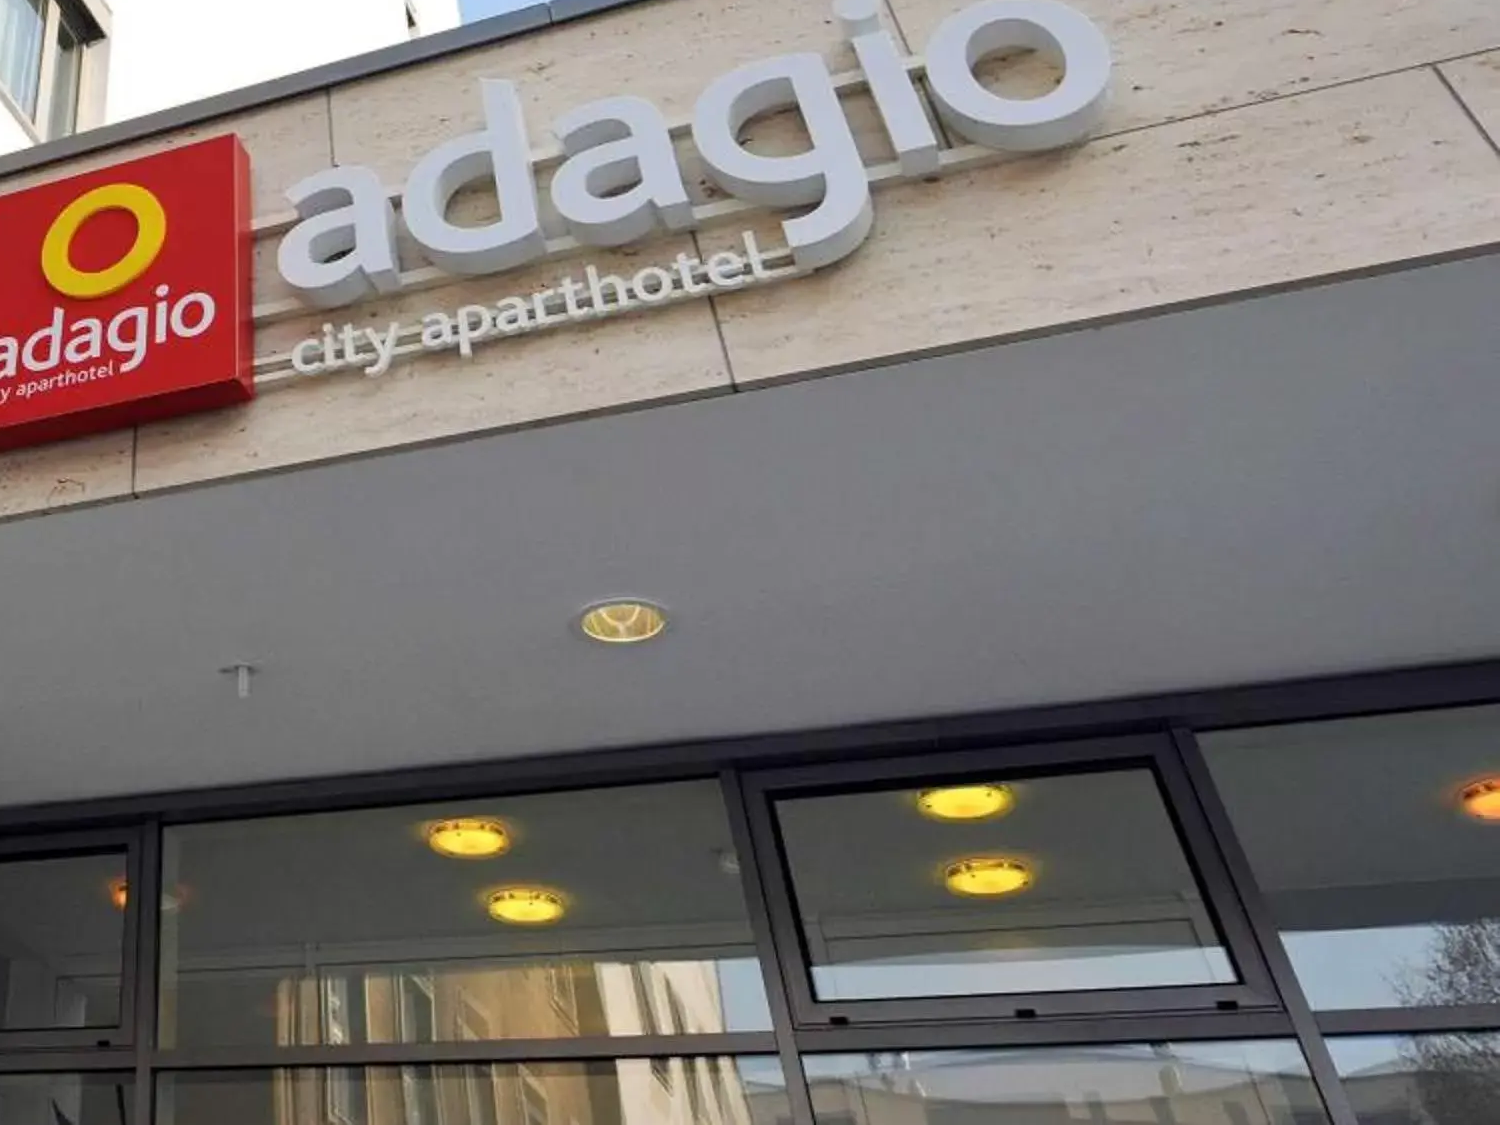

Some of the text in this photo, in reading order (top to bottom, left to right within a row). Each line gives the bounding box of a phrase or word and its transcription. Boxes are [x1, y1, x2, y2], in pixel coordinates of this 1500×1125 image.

[290, 230, 772, 375] city aparthotel
[15, 359, 114, 399] aparthotel
